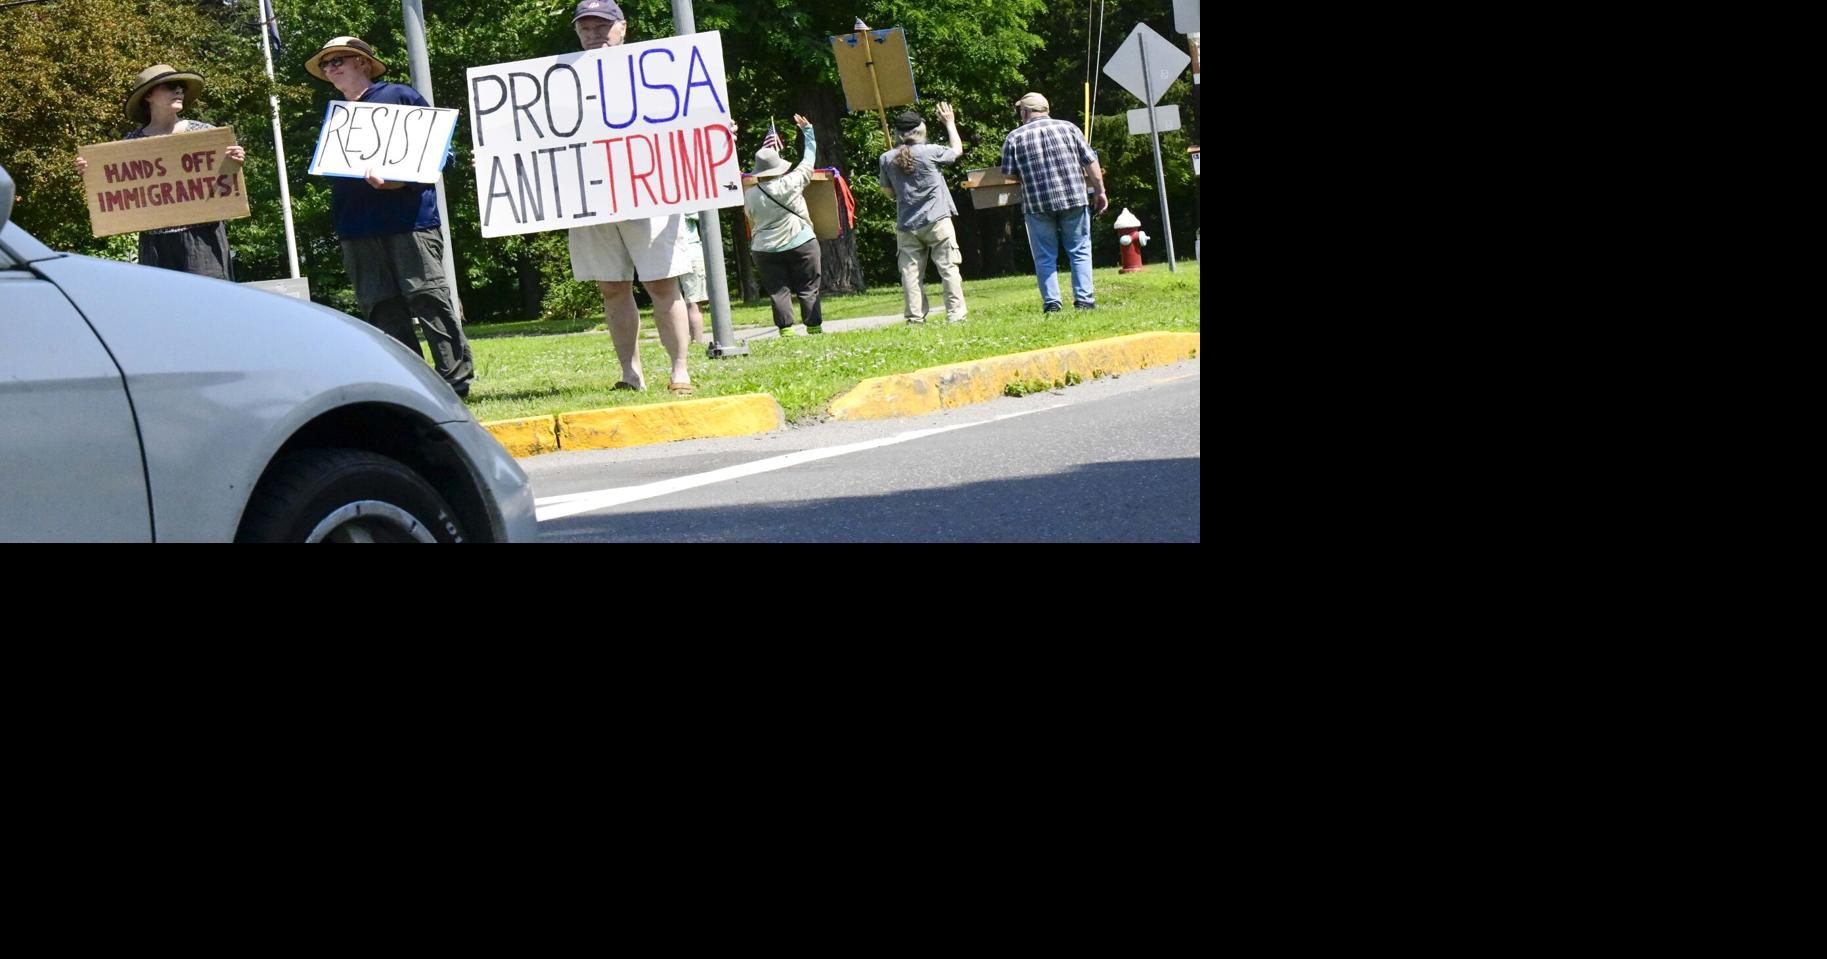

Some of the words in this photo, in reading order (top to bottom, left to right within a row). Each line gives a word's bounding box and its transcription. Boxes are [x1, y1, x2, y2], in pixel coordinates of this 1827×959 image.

[472, 46, 725, 146] PRO-USA
[104, 158, 166, 183] HANDS
[181, 151, 216, 173] OFF
[318, 105, 451, 172] RESIST
[97, 173, 240, 213] IMMIGRANTS!
[483, 124, 734, 227] ANTI-TRUMP
